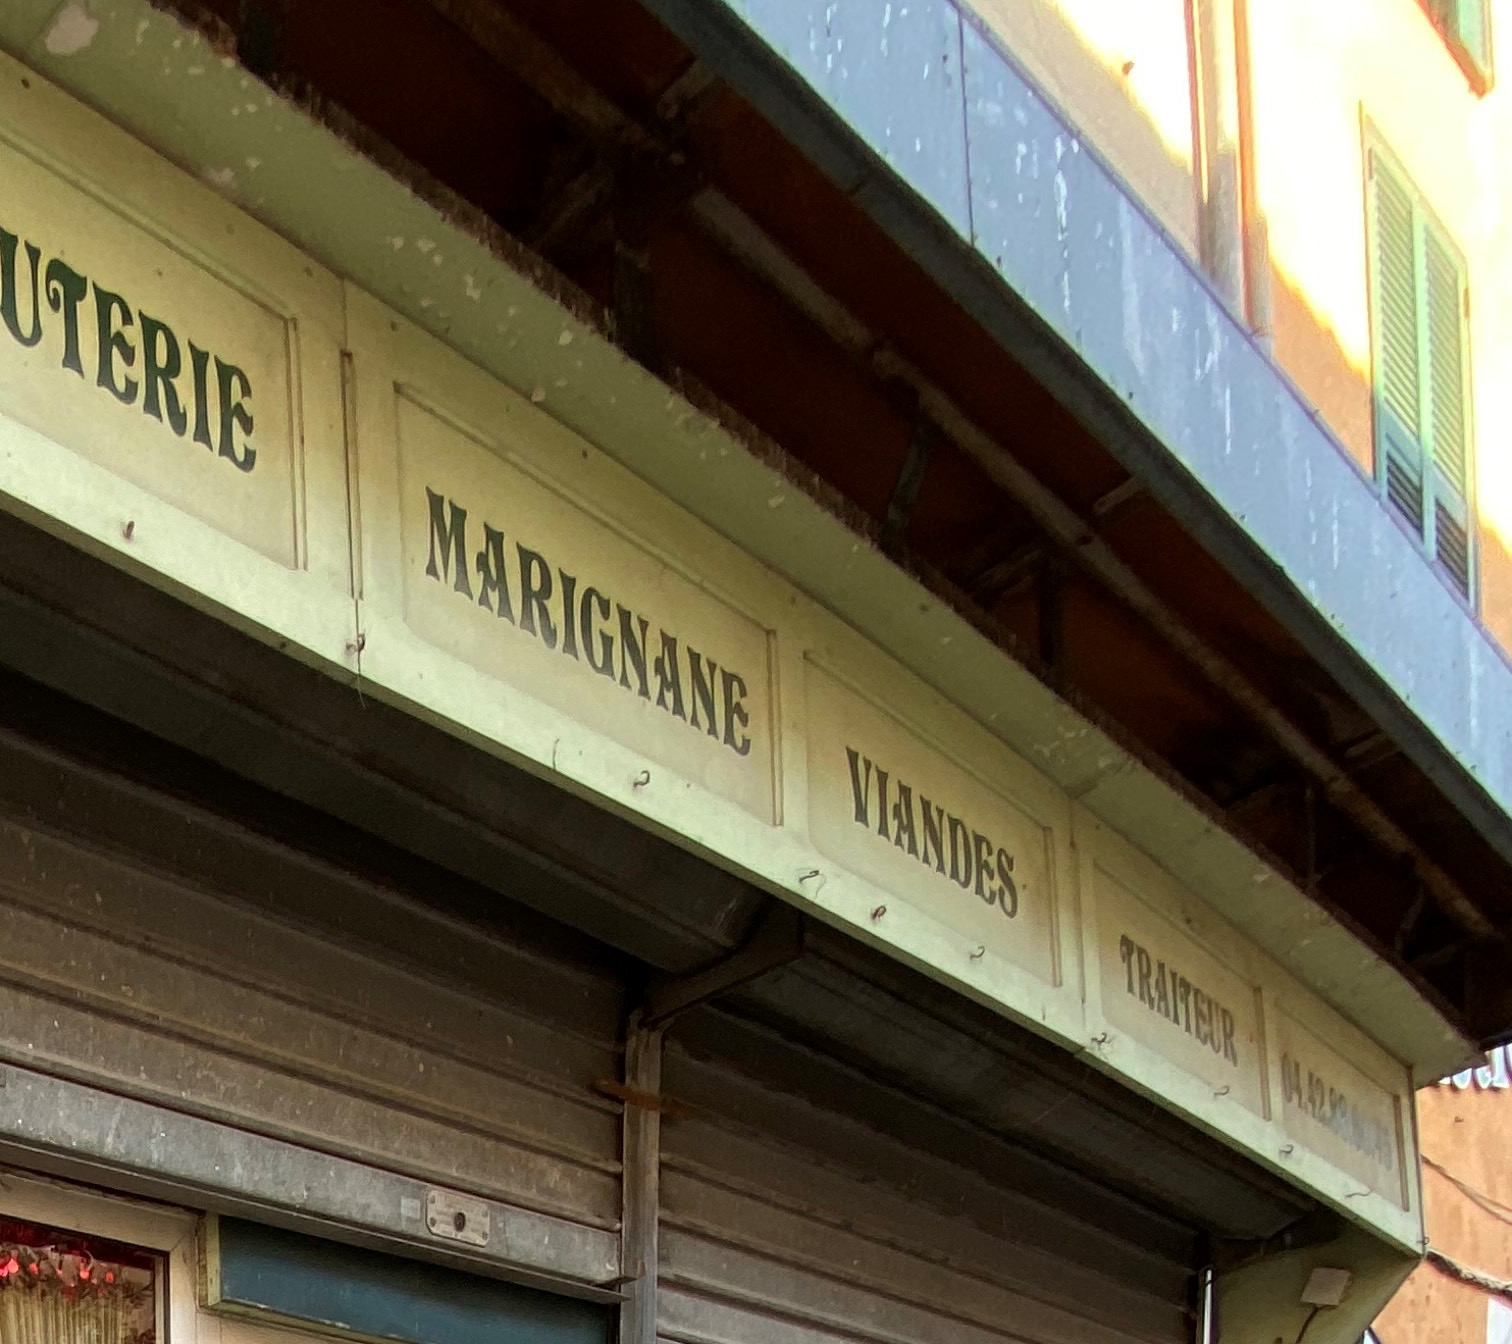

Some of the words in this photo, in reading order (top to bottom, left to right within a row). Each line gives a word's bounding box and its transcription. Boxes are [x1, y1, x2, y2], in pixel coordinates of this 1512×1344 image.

[424, 485, 752, 756] MARIGNANE
[845, 746, 1020, 920] VIANDES
[1119, 933, 1239, 1068] TRAITEUR
